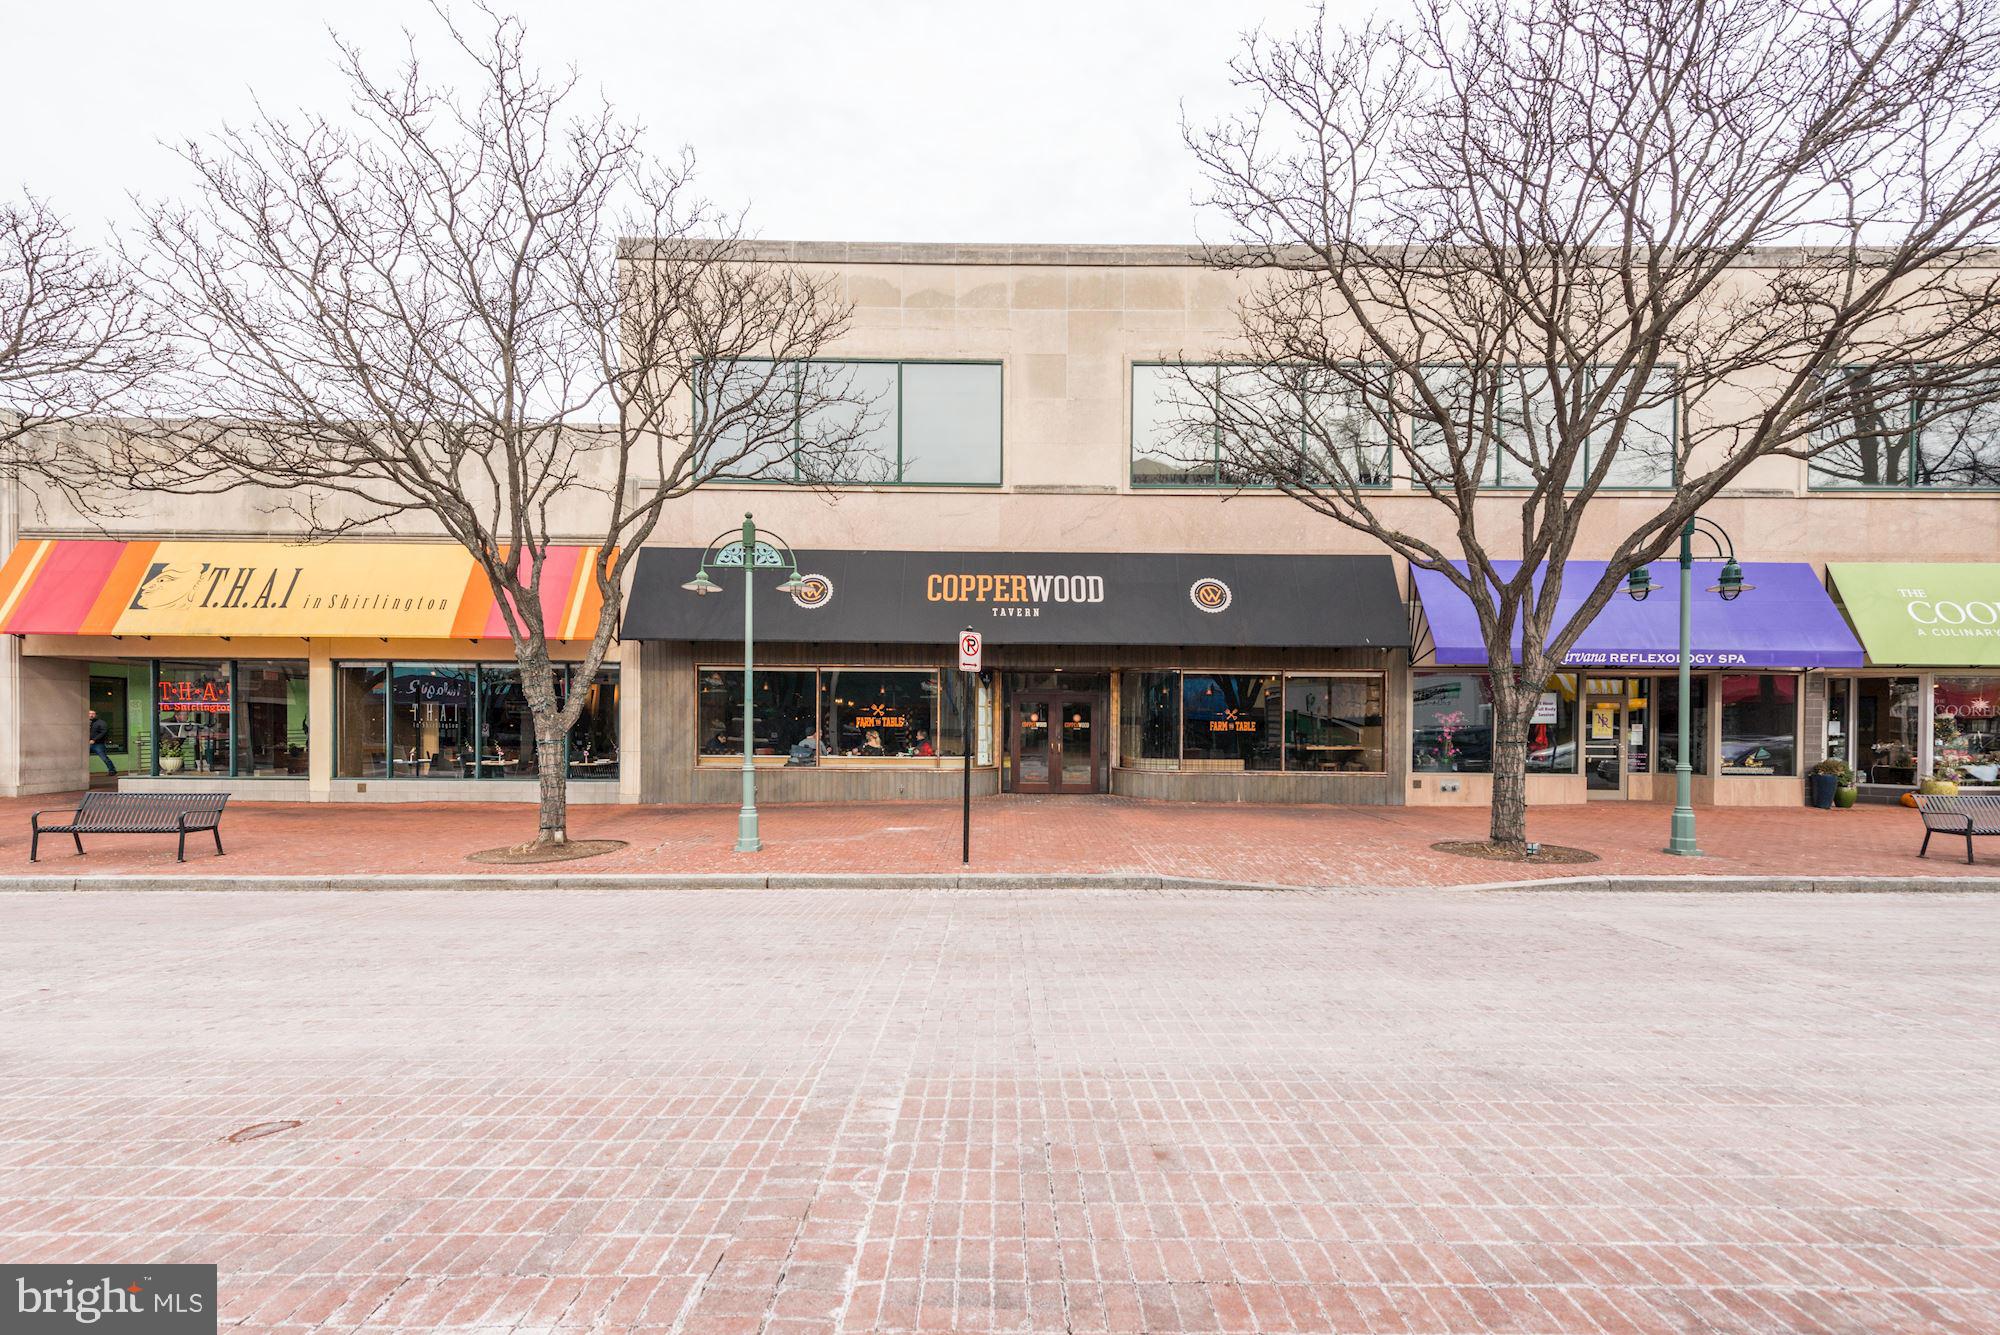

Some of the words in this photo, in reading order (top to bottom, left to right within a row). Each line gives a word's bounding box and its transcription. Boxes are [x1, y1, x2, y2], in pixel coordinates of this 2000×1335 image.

[199, 567, 304, 608] T.H.A.I
[303, 594, 322, 609] in
[328, 594, 448, 611] Shirlington
[927, 574, 1105, 603] COPPERWOOD
[1897, 588, 1927, 598] THE
[992, 607, 1040, 617] TAVERN
[1907, 600, 2000, 624] COO
[1918, 628, 1927, 636] A
[1561, 651, 1606, 664] irvana
[1718, 654, 1746, 664] SPA
[856, 716, 875, 728] FARM
[882, 716, 904, 727] TABLE
[1210, 721, 1228, 731] FARM
[1235, 721, 1256, 731] TABLE
